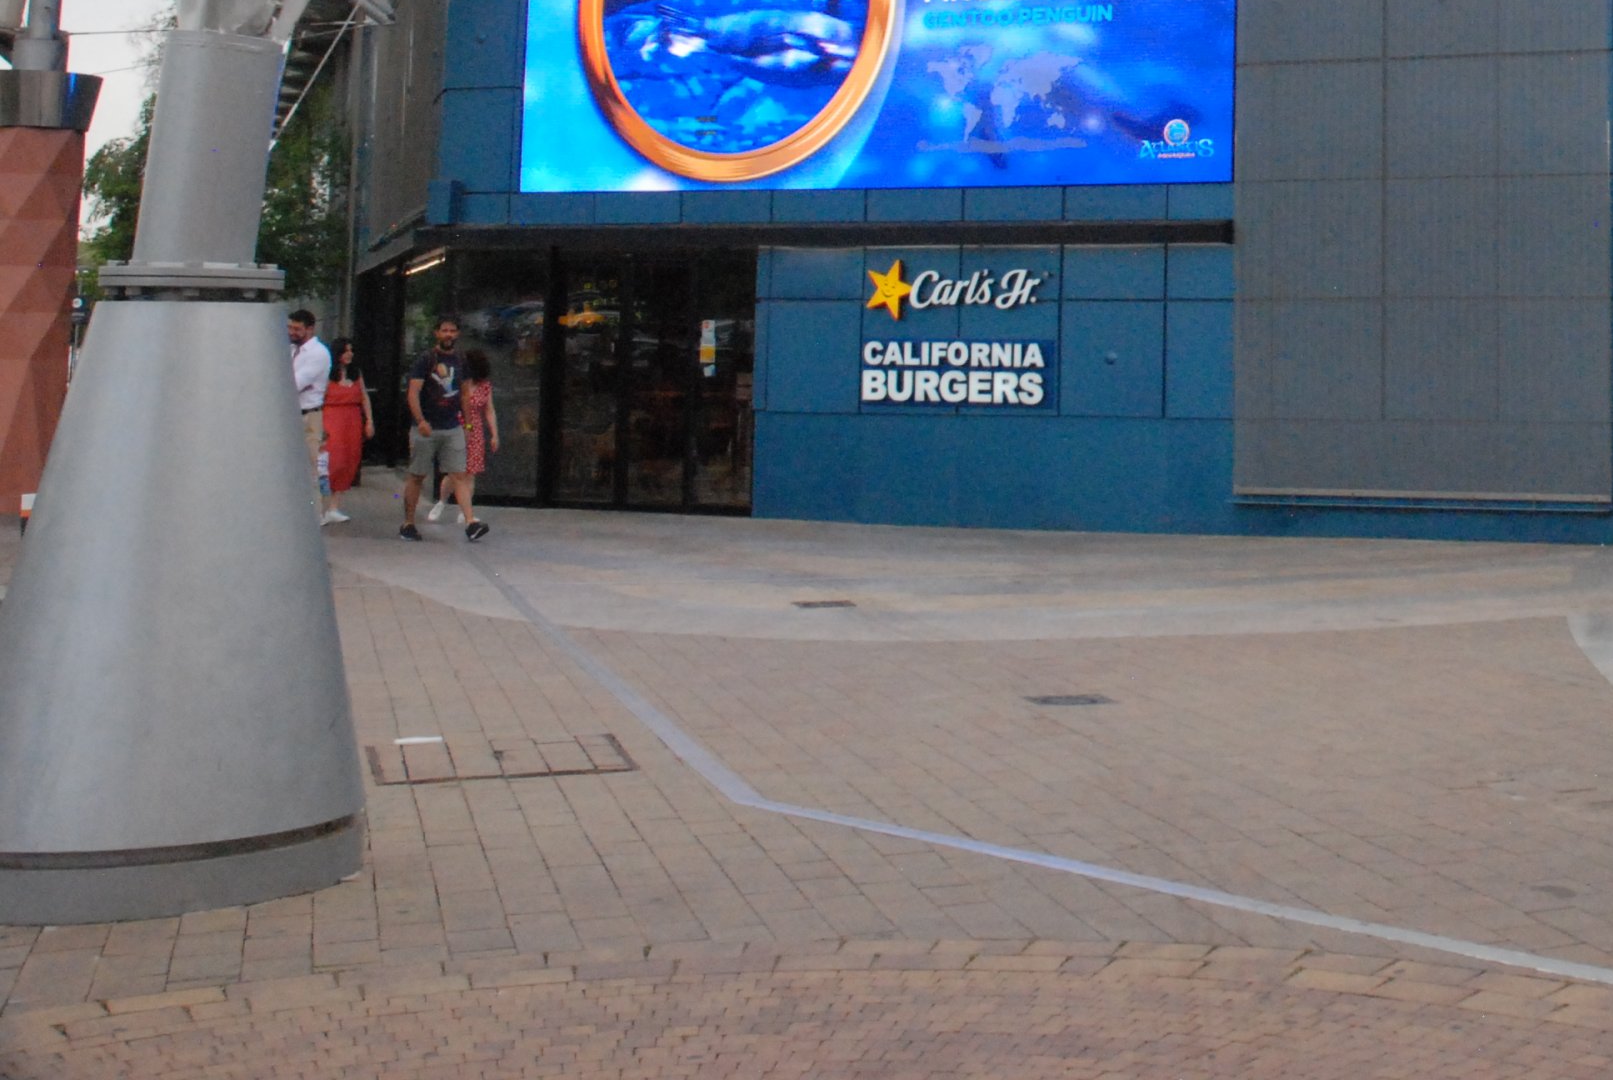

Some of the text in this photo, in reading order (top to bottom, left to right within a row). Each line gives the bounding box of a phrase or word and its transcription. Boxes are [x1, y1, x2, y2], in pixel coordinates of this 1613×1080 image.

[923, 4, 1113, 29] GENTOO PENGUIN
[909, 269, 1040, 309] Carl's Jr.
[863, 340, 1045, 368] CALIFORNIA
[862, 369, 1044, 405] BURGERS
